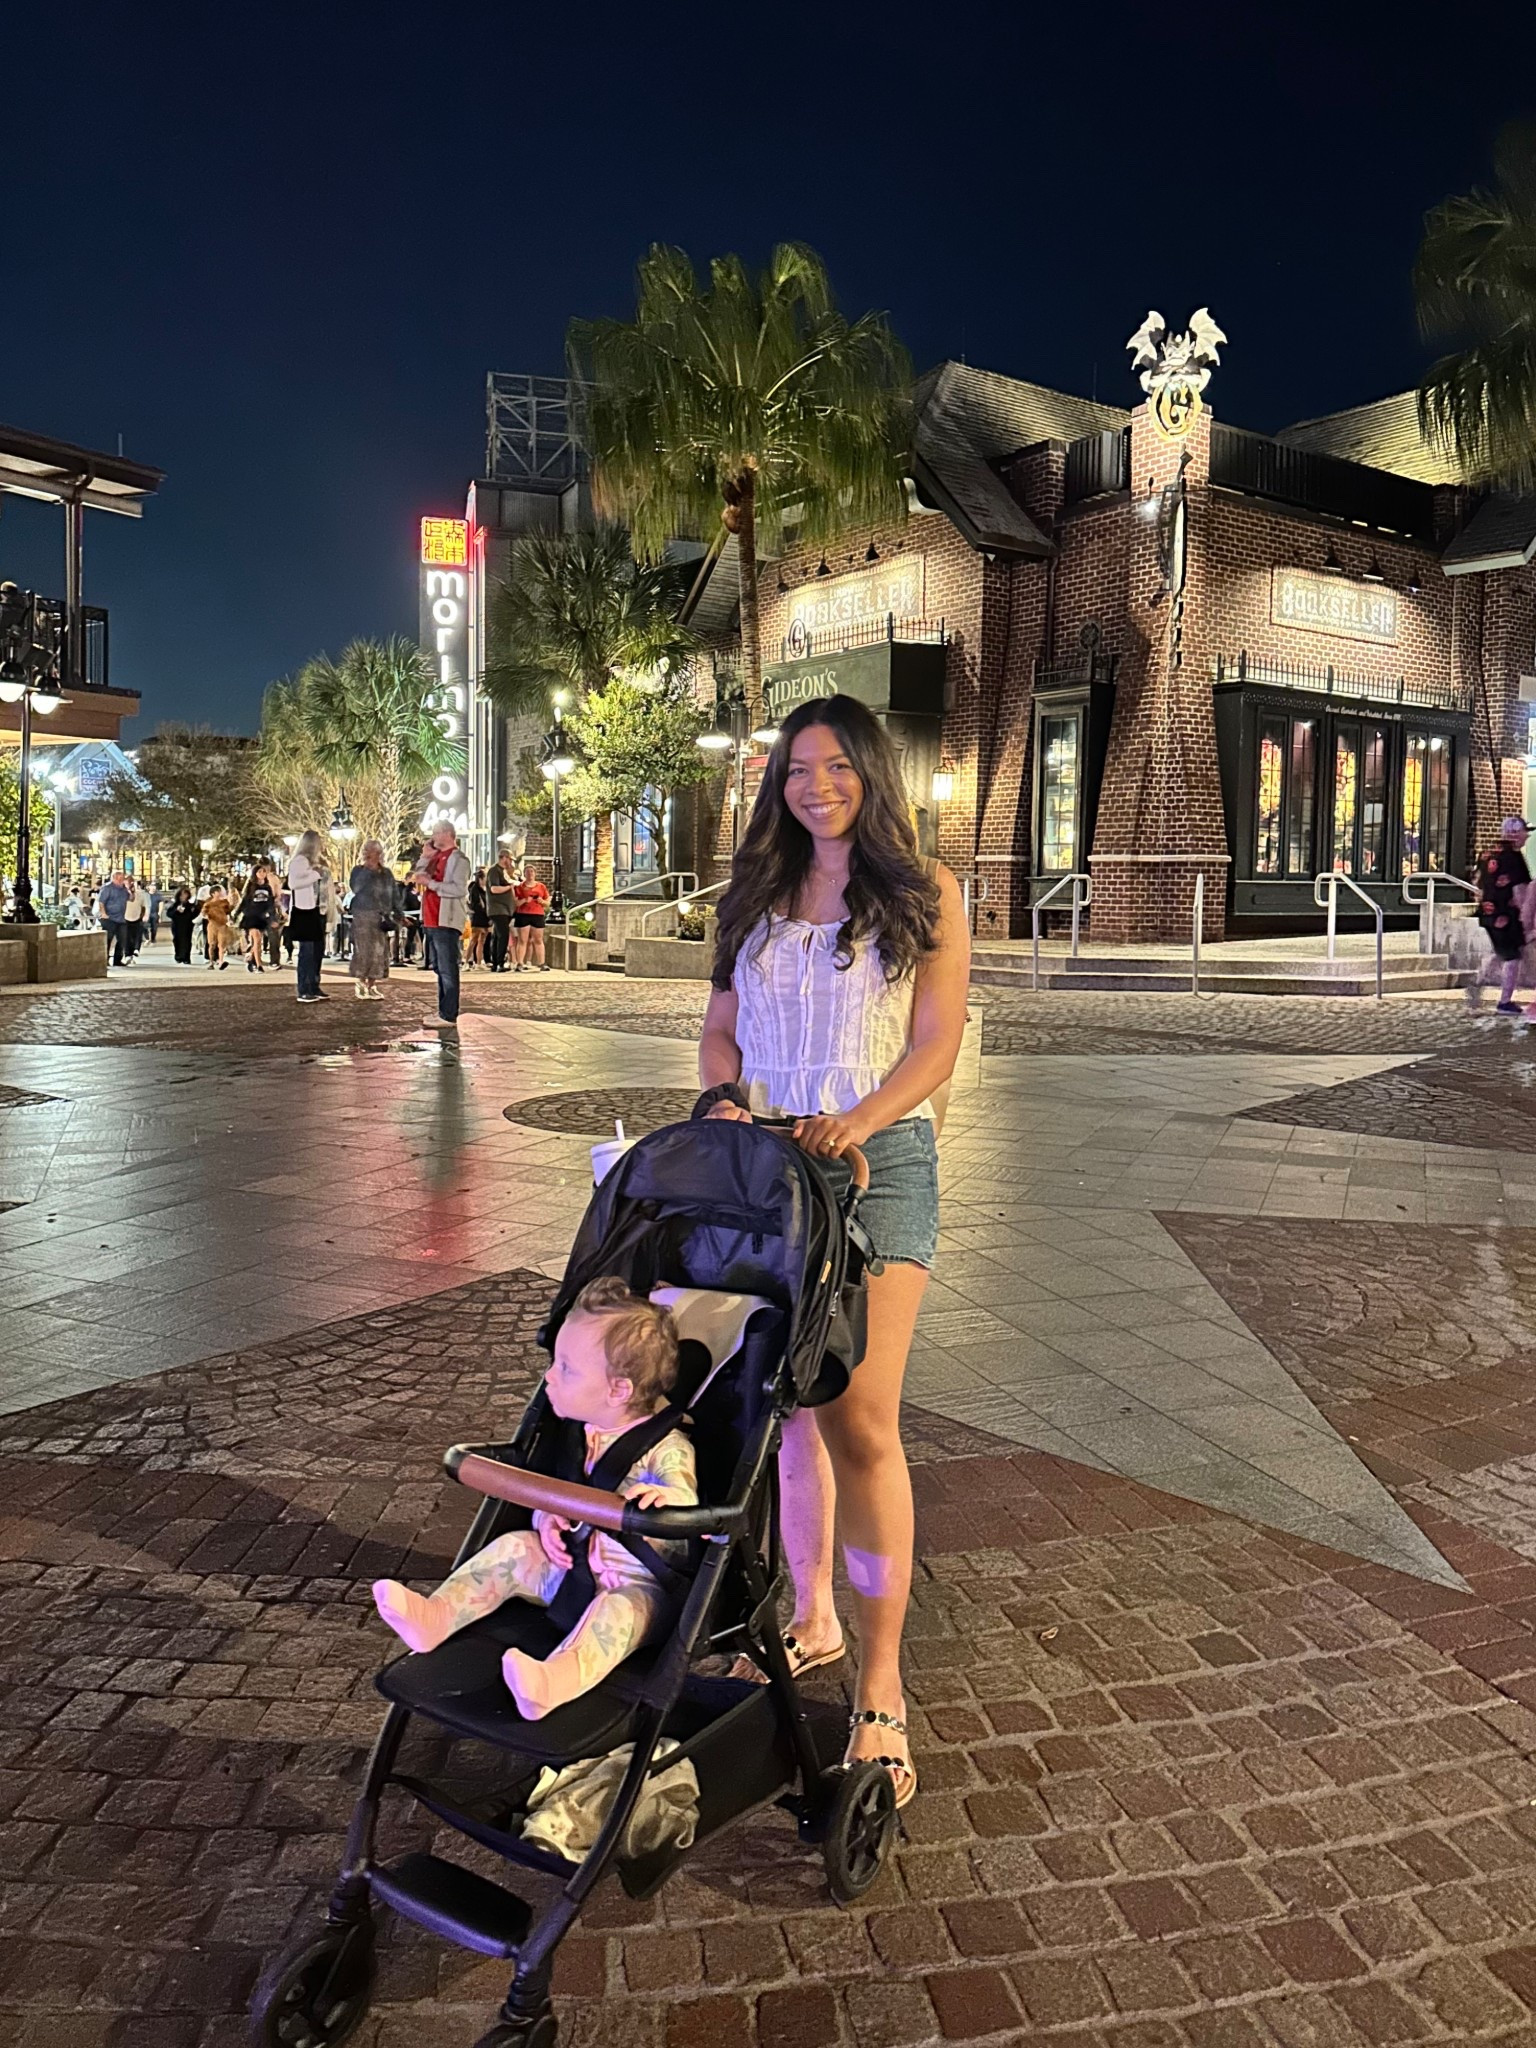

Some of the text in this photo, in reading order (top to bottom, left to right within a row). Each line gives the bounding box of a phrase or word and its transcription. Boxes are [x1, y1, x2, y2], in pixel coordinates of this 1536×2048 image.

[1282, 581, 1394, 634] BOOKSELLER
[426, 570, 465, 801] morimoo
[761, 667, 839, 708] GIDEON'S
